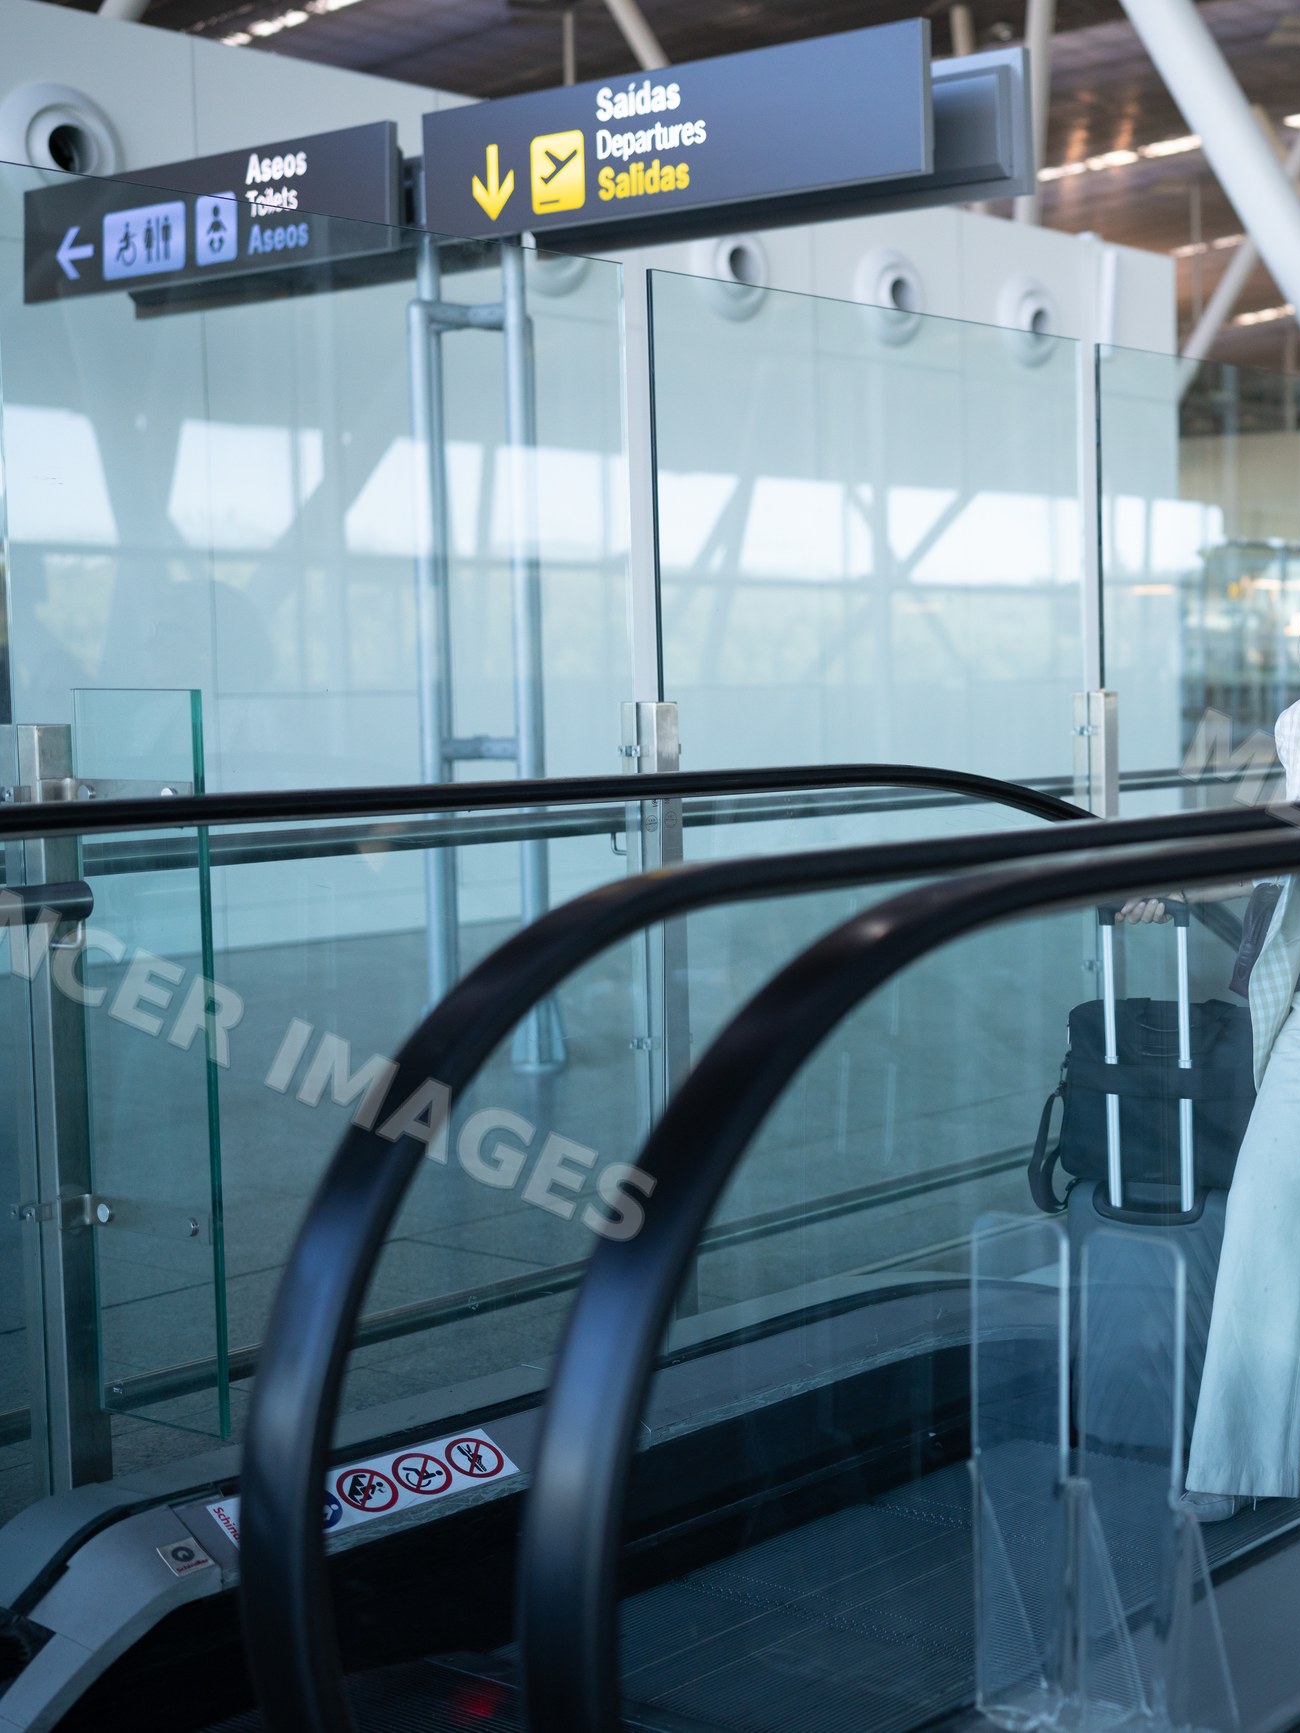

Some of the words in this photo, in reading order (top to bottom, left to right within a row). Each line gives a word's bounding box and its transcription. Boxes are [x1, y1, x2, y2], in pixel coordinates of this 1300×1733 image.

[596, 79, 681, 122] Saídas
[596, 119, 707, 161] Departures
[245, 151, 308, 185] Aseos
[598, 158, 690, 201] Salidas
[247, 222, 309, 256] Aseos
